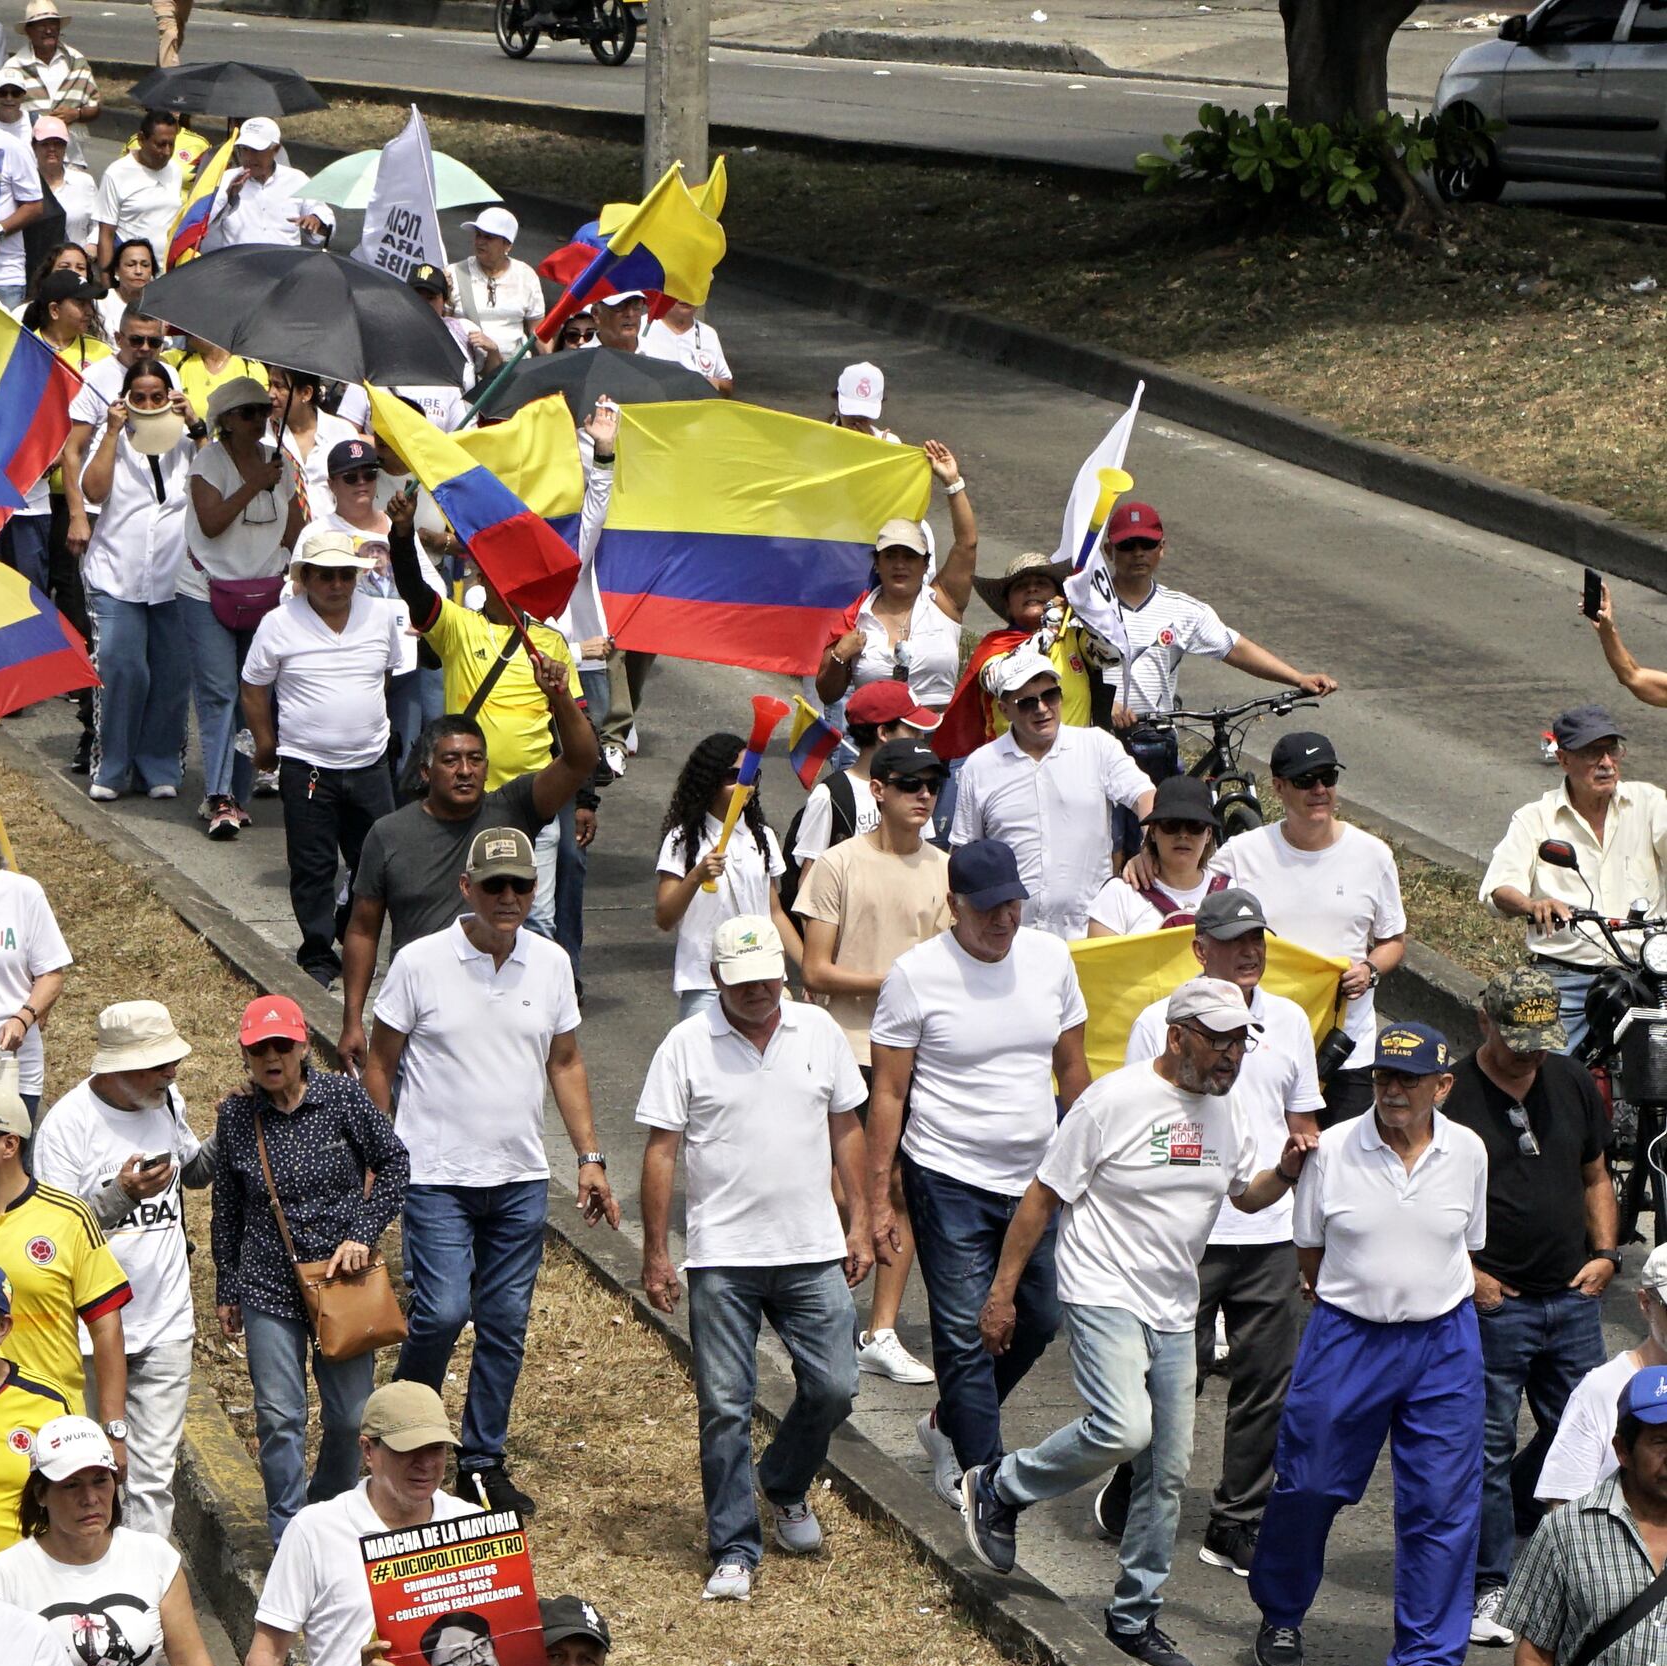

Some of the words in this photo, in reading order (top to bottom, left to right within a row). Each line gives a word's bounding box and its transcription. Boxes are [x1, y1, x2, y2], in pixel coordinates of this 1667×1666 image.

[1151, 1123, 1171, 1165] UAE
[1171, 1122, 1204, 1135] HEALTHY
[1171, 1132, 1204, 1145] KIDNEY
[365, 1531, 420, 1561] MARCHA
[421, 1526, 440, 1549] DE
[441, 1522, 458, 1544] LA
[459, 1511, 520, 1541] MAYORIA
[371, 1535, 524, 1584] #JUICIOPOLITICOPETRO
[403, 1571, 459, 1594] CRIMINALES
[459, 1563, 498, 1583] SUELTOS
[421, 1584, 467, 1605] GESTORES
[467, 1577, 493, 1596] PASS
[395, 1601, 451, 1622] COLECTIVOS
[451, 1588, 524, 1613] ESCLAVIZACION.
